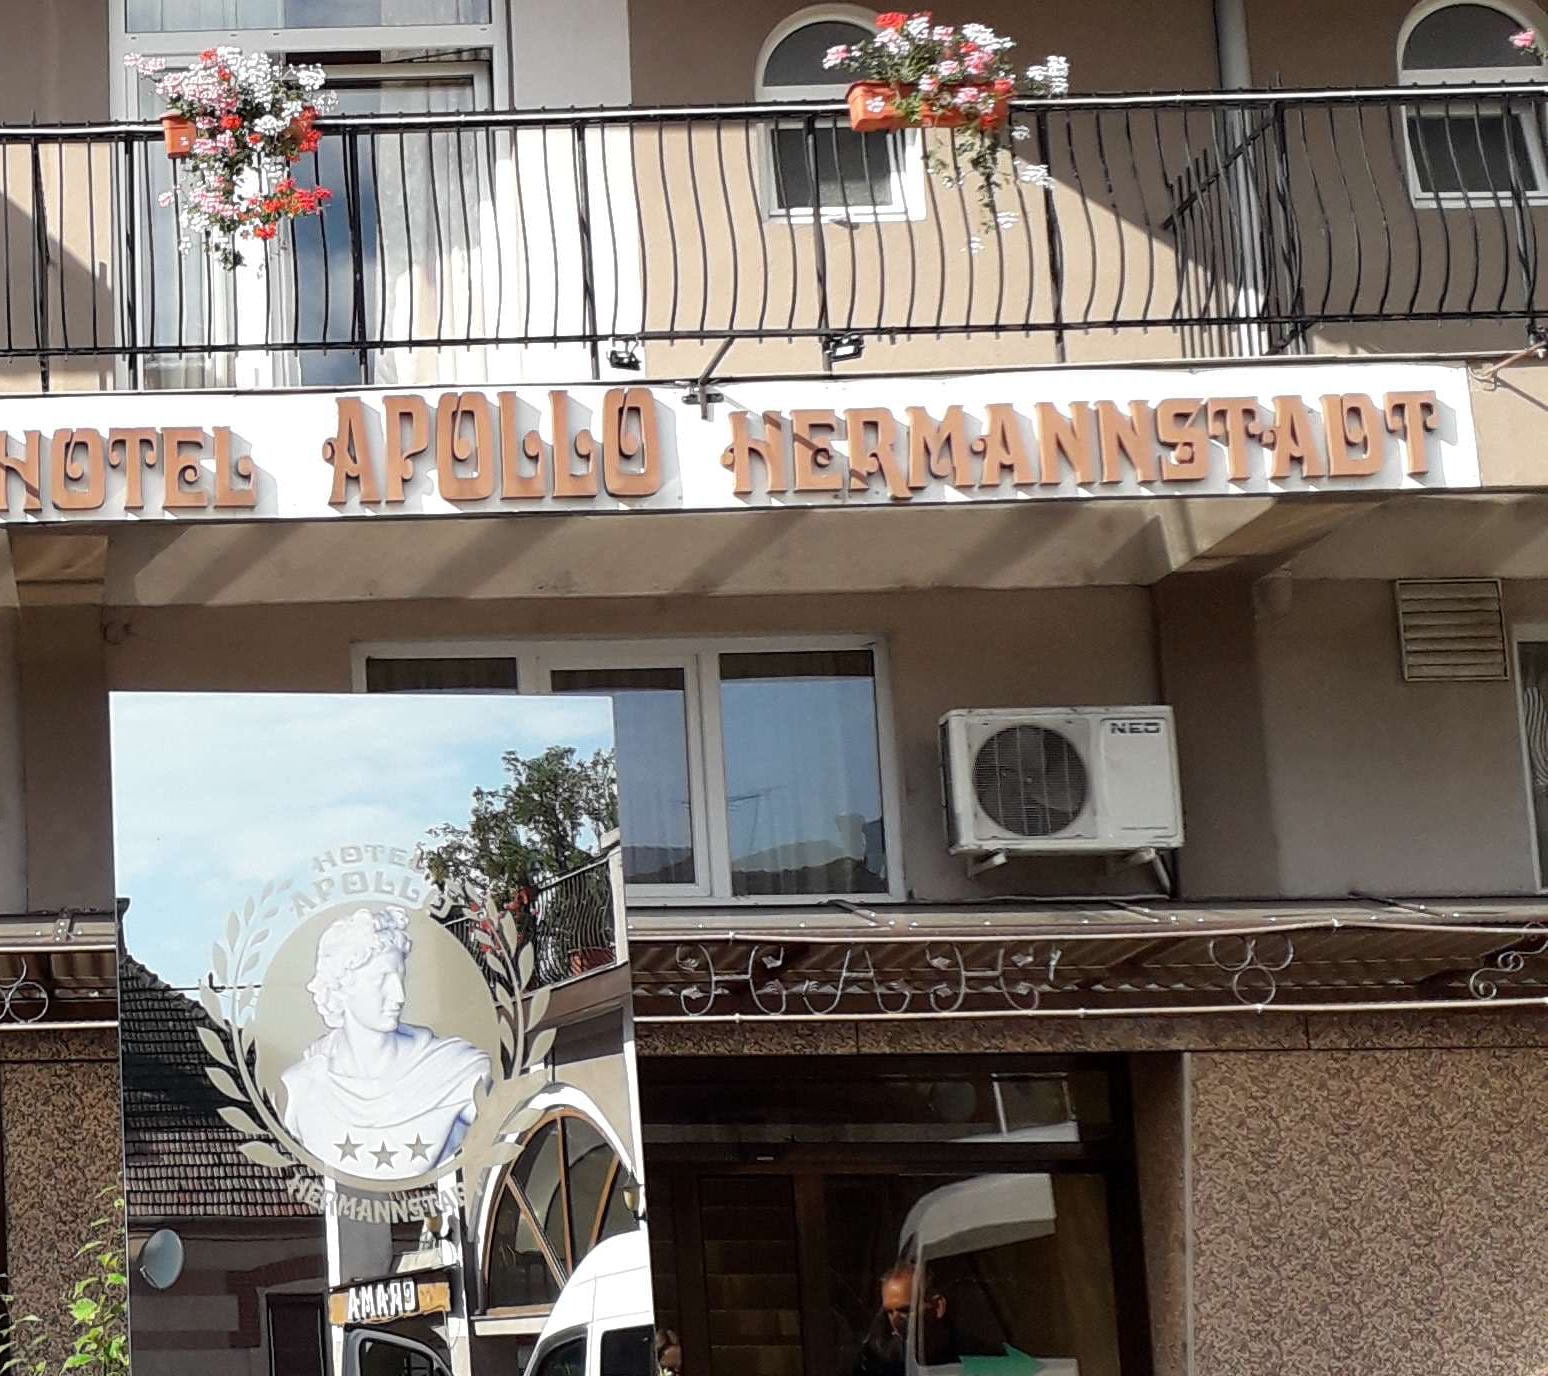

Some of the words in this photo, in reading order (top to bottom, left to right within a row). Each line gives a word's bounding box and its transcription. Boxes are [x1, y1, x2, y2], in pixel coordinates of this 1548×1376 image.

[323, 387, 660, 508] APOLLO
[720, 390, 1437, 500] HERMANNSTADT
[310, 842, 427, 873] HOTEL
[290, 870, 453, 919] APOLLO
